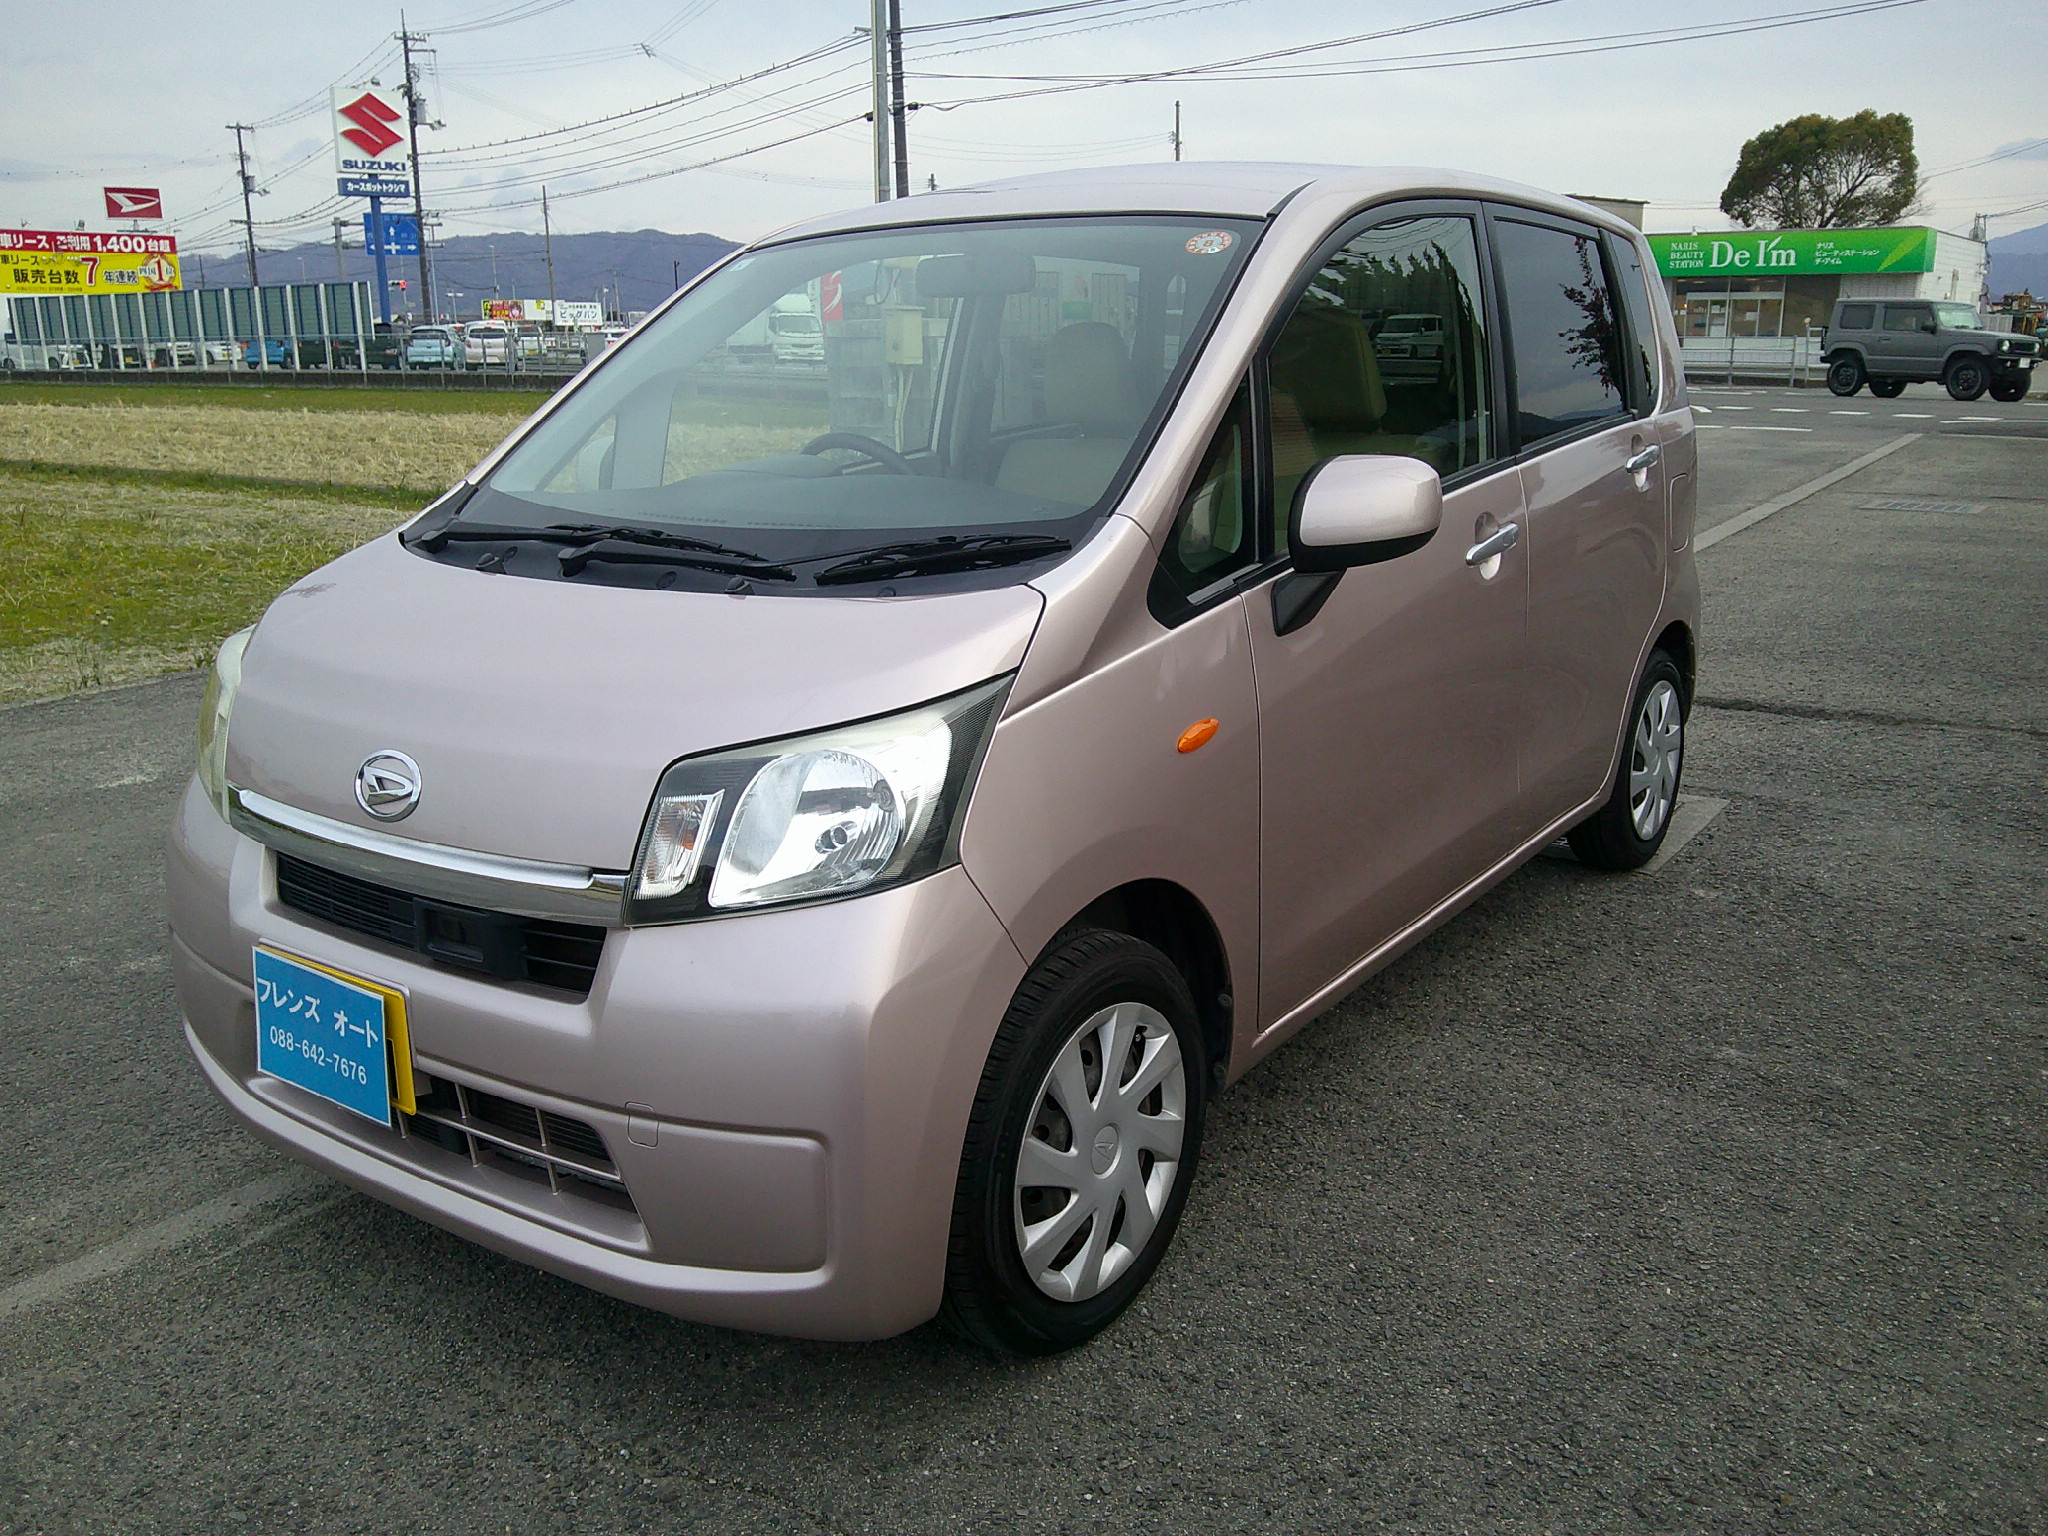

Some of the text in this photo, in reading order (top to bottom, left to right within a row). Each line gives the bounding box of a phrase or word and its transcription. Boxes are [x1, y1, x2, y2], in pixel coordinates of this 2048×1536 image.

[342, 159, 406, 171] SUZUKI
[347, 182, 405, 193] カースポットトクシマ
[1671, 242, 1699, 250] NARIS
[1670, 251, 1705, 259] BEAUTY
[1709, 241, 1750, 268] De
[1669, 260, 1704, 268] STATION
[13, 269, 80, 284] 販売台数
[80, 255, 100, 286] 7
[103, 270, 138, 285] 年連続
[257, 977, 379, 1049] フレンズ オート
[269, 1025, 368, 1085] 088-642-7676
